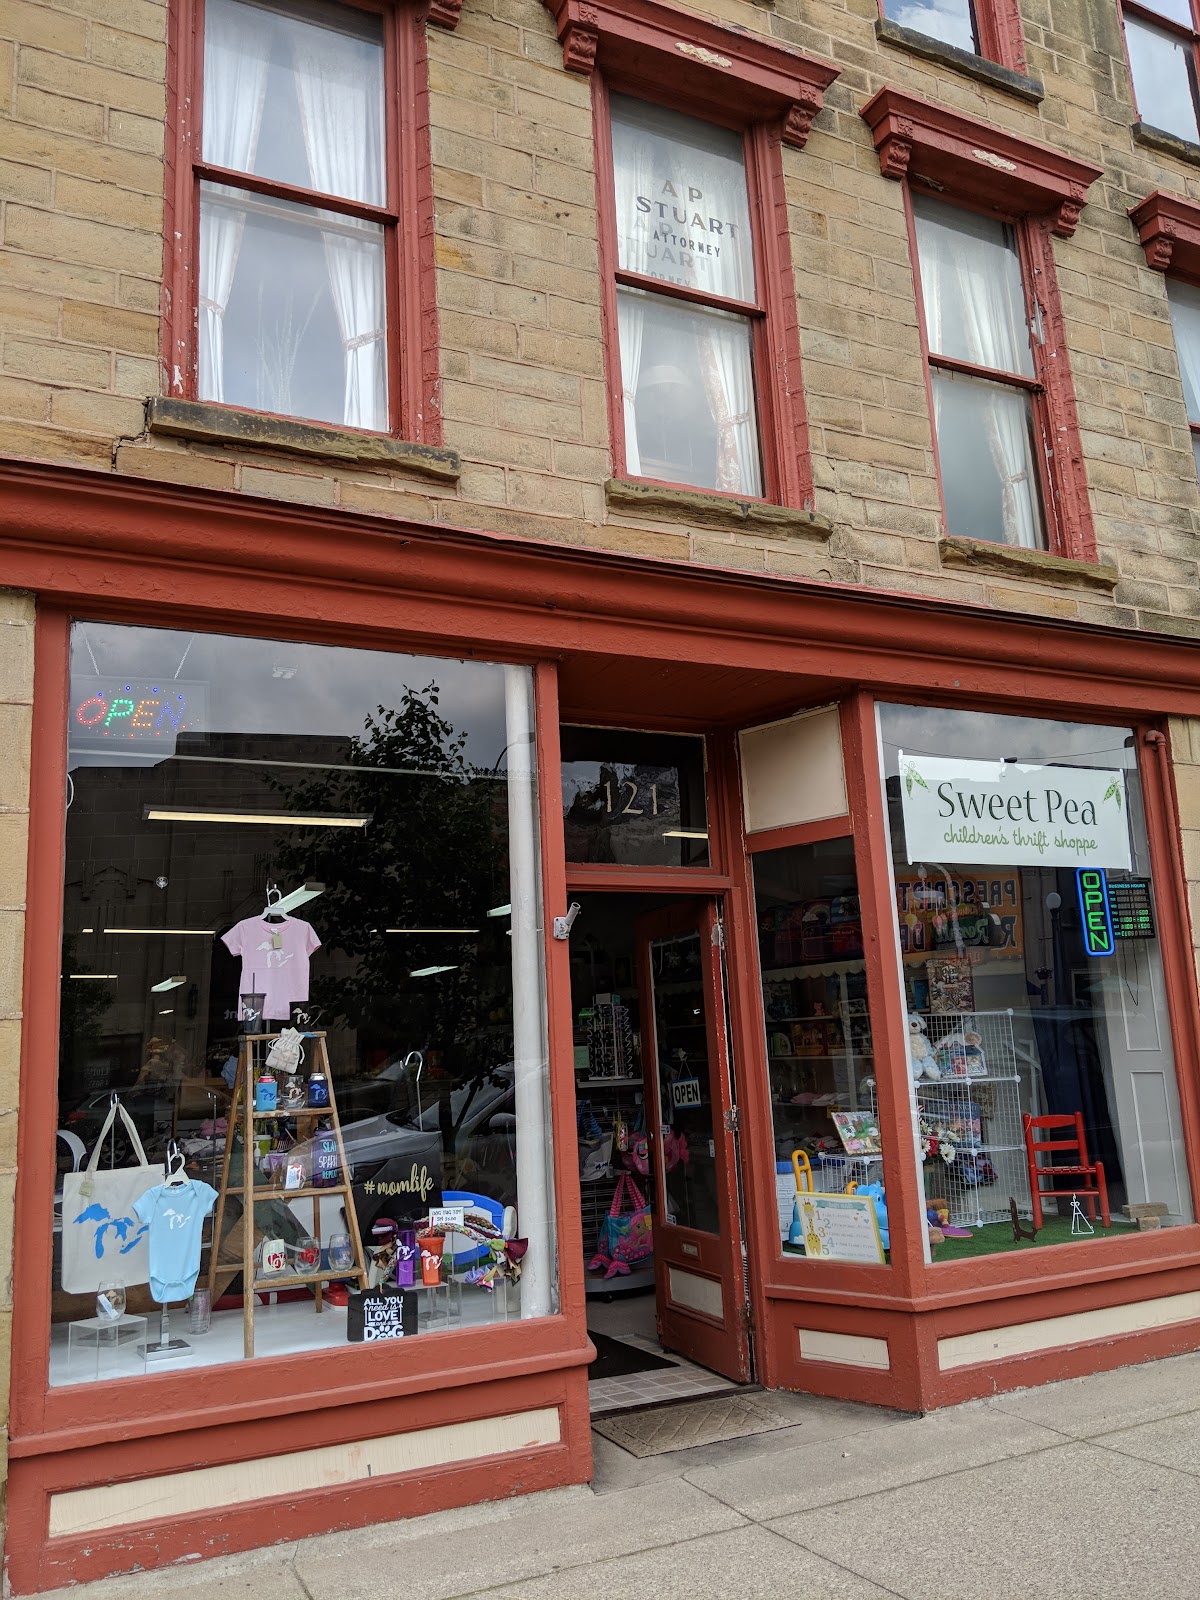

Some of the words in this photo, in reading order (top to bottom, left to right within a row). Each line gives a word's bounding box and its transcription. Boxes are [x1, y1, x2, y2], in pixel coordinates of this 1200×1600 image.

[661, 180, 678, 198] A
[688, 186, 703, 202] P
[636, 196, 740, 240] STUART
[653, 230, 720, 257] ATTORNEY
[77, 698, 186, 728] OPEN
[603, 780, 658, 816] 121
[937, 782, 1040, 823] Sweet
[1044, 789, 1099, 826] Pea
[1013, 828, 1050, 855] thrift
[1054, 830, 1098, 856] shoppe
[1082, 872, 1109, 951] OPEN
[674, 1082, 699, 1104] OPEN
[364, 1163, 434, 1202] #momlife
[364, 1297, 383, 1306] ALL
[384, 1296, 403, 1304] YOU
[368, 1310, 399, 1321] LOVE
